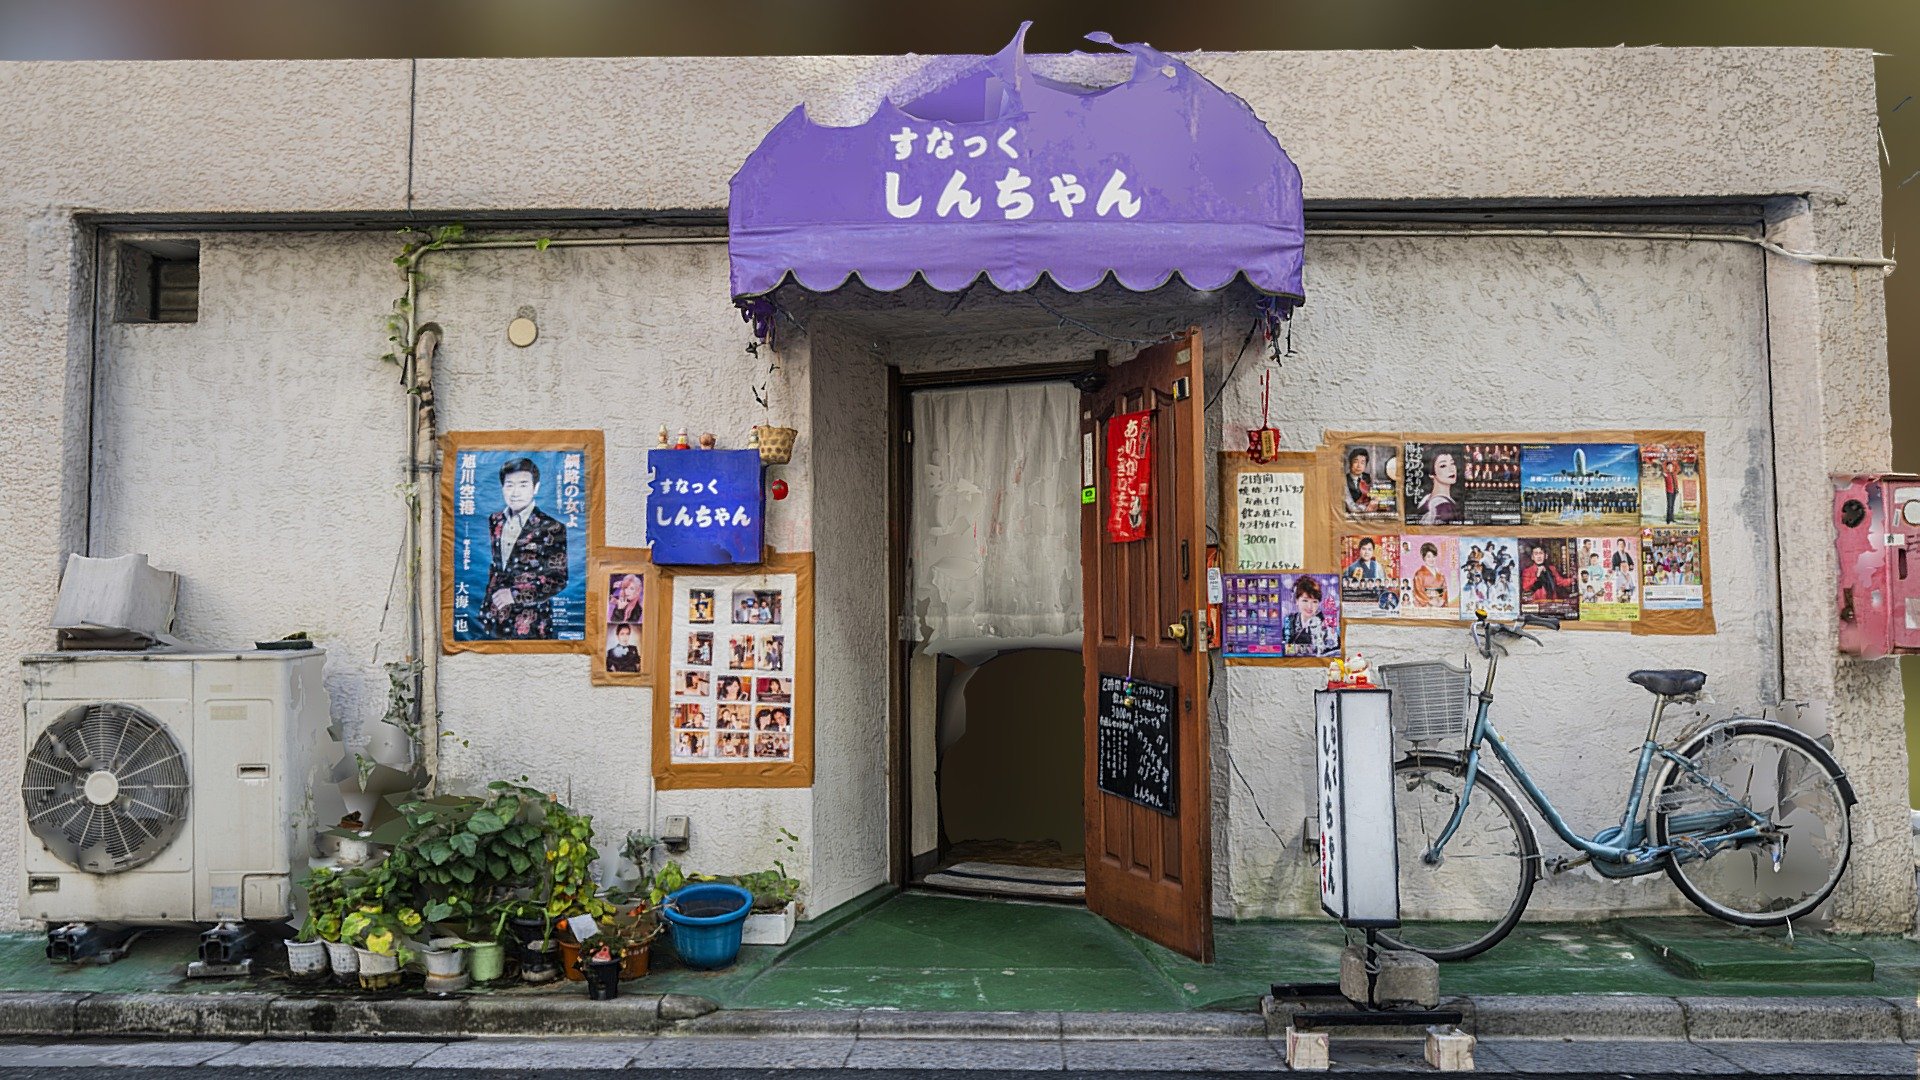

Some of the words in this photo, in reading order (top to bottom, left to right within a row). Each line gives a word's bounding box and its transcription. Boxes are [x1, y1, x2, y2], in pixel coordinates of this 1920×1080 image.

[890, 126, 1019, 160] すなっく
[884, 167, 1142, 219] しんちゃん
[459, 453, 476, 515] 旭川空港
[660, 478, 718, 494] すなっく
[657, 505, 751, 528] しんちゃん
[1243, 534, 1277, 545] 3000円
[455, 582, 469, 633] 大海一也
[1323, 725, 1336, 895] しんちゃん
